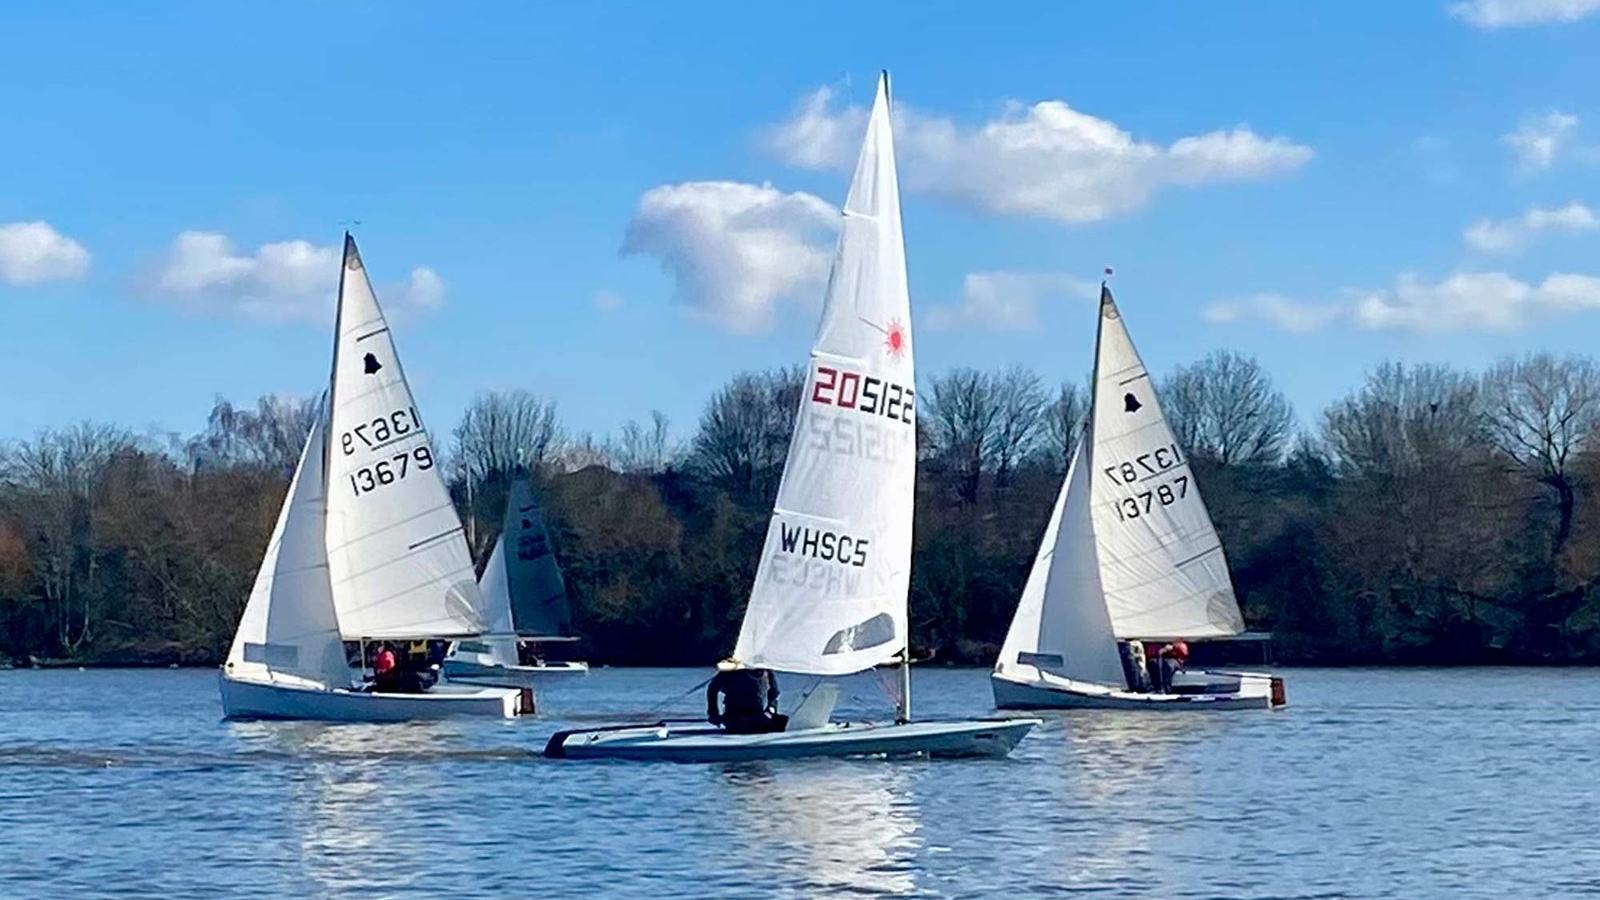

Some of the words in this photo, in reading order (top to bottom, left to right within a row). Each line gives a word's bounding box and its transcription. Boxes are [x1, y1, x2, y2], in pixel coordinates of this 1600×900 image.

[812, 368, 914, 424] 205122
[350, 446, 433, 497] 13679
[1115, 476, 1188, 522] 13787
